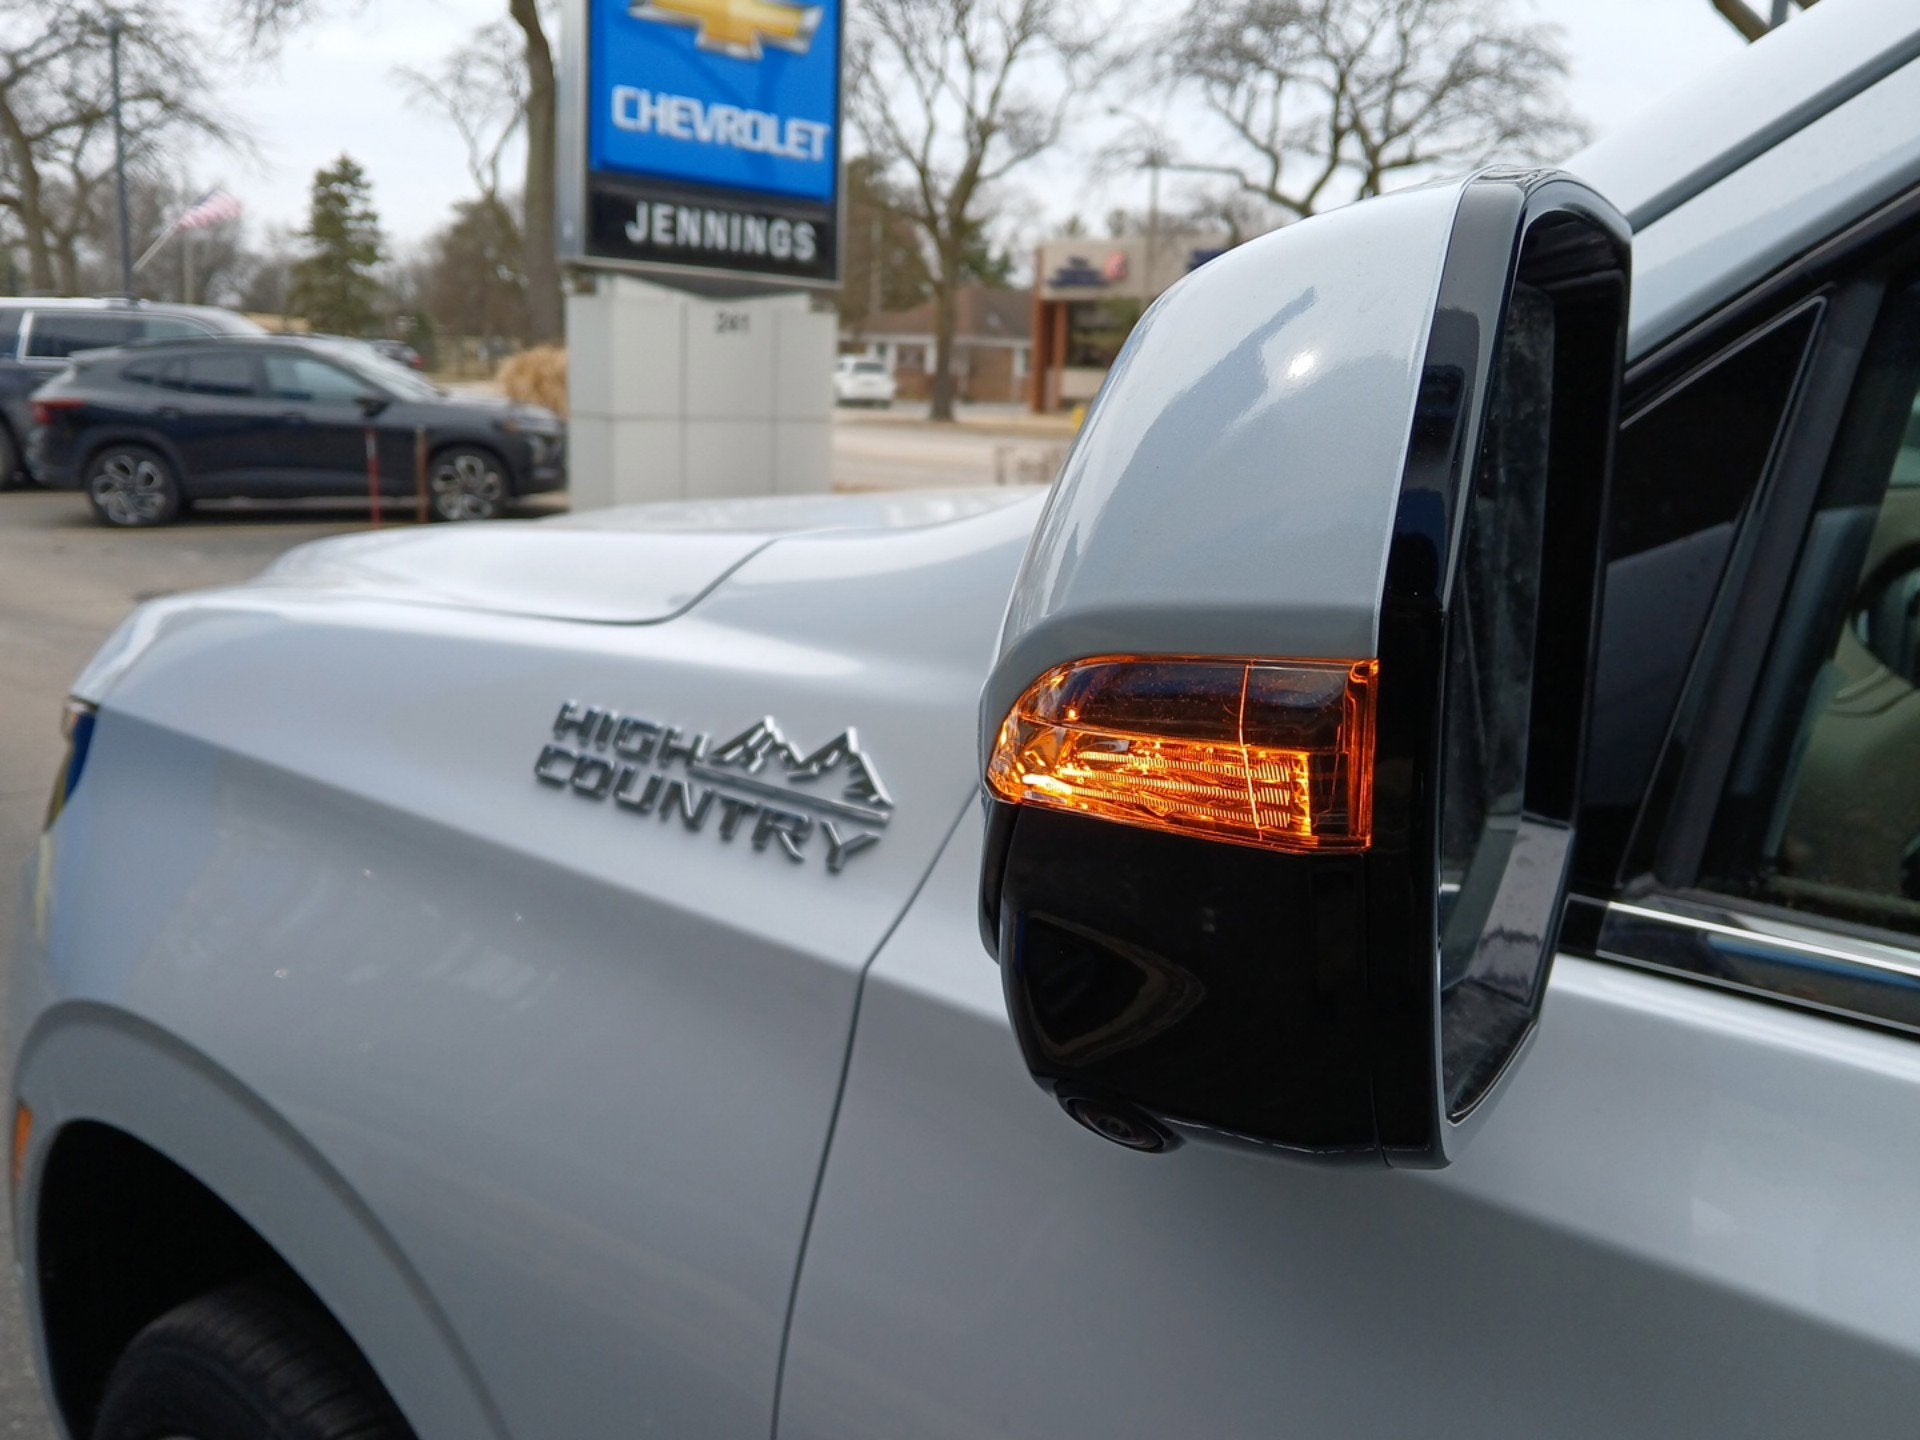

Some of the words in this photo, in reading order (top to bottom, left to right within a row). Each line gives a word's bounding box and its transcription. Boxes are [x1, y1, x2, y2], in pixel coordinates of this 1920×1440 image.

[611, 84, 831, 161] CHEVROLET
[624, 201, 817, 262] JENNINGS
[552, 700, 709, 767] HIGH
[535, 744, 881, 874] COUNTRY
